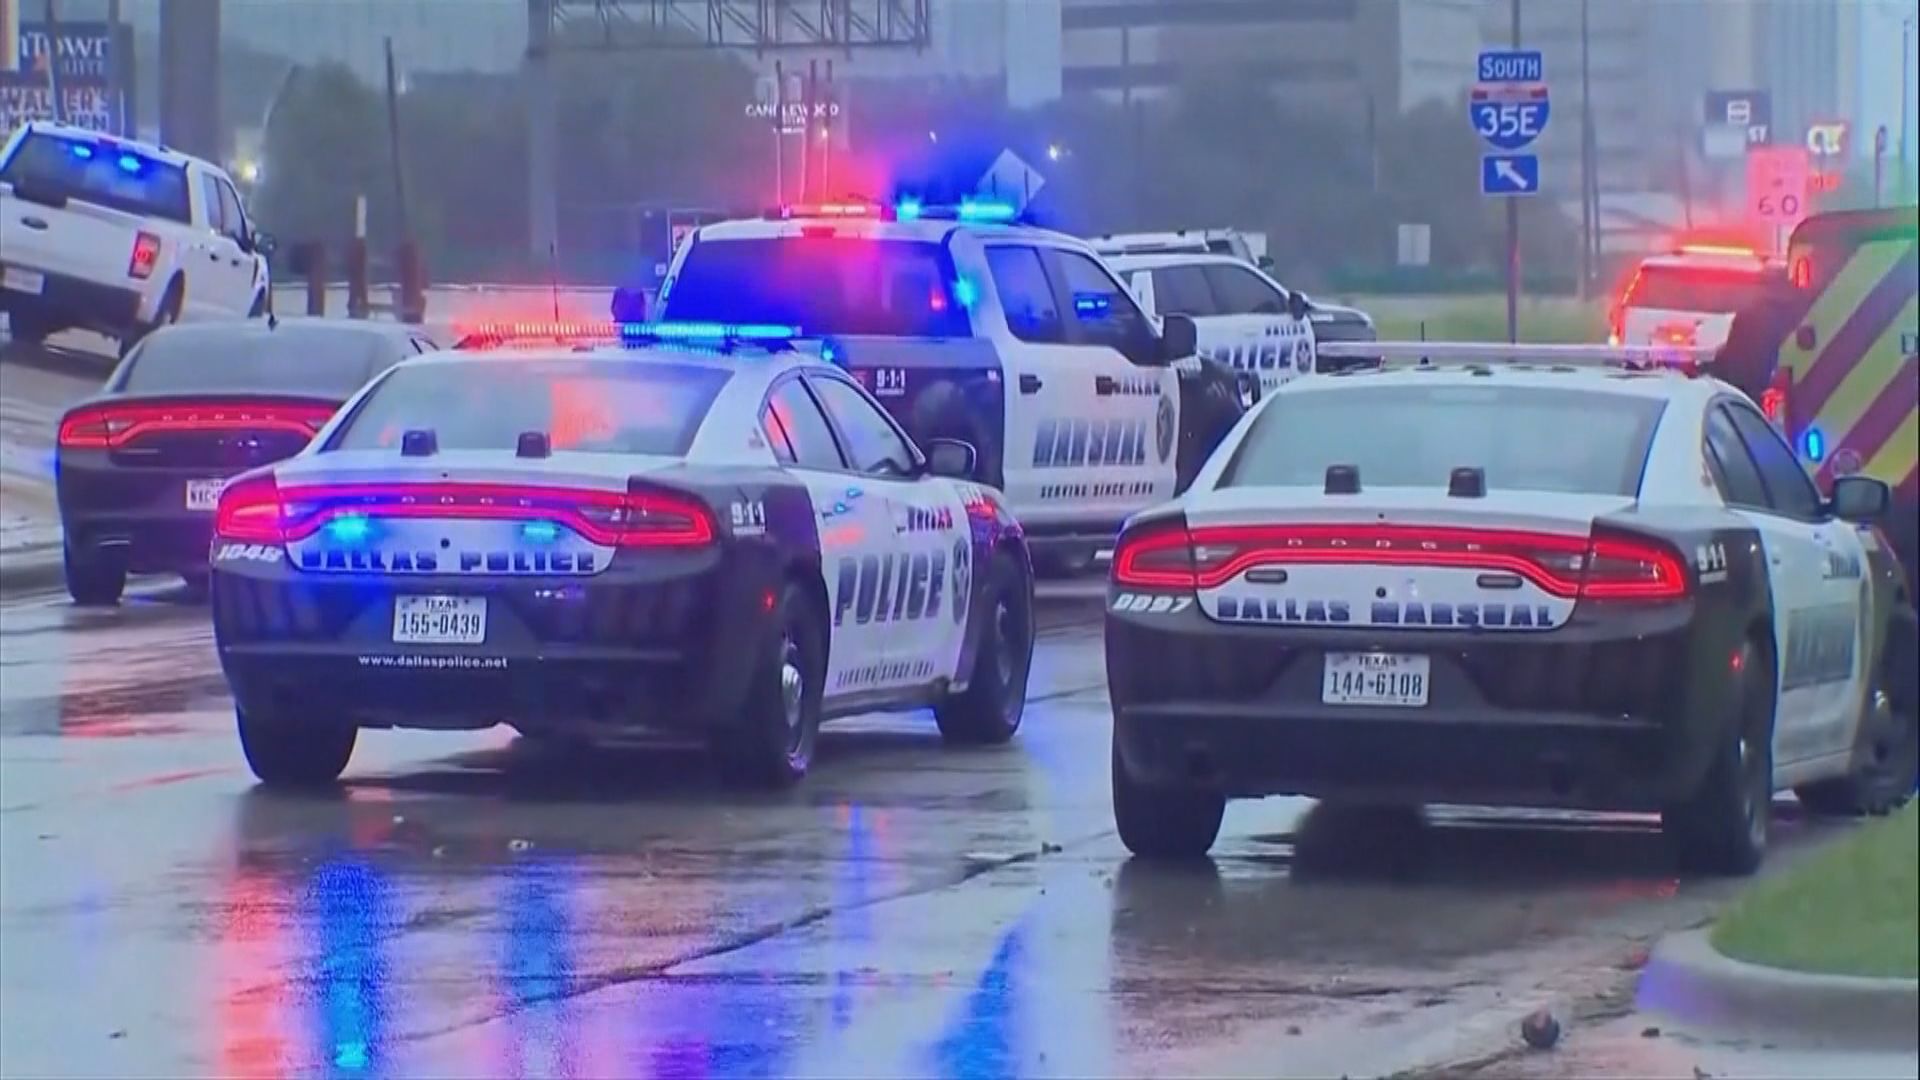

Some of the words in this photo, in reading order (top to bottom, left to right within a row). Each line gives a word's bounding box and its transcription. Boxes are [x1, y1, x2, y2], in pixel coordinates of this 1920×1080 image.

[1482, 56, 1539, 79] SOUTH
[1480, 105, 1539, 137] 35E
[1758, 194, 1798, 216] 60
[1032, 416, 1147, 468] MARSHAL
[1040, 483, 1088, 499] SERVING
[1093, 482, 1125, 497] SINCE
[301, 551, 438, 572] DALLAS
[459, 551, 594, 573] POLICE
[834, 553, 946, 627] POLICE
[1217, 597, 1349, 622] DALLAS
[1371, 602, 1554, 627] MARSHAL
[358, 655, 509, 670] www.dallaspolice.net
[1358, 656, 1397, 668] TEXAS
